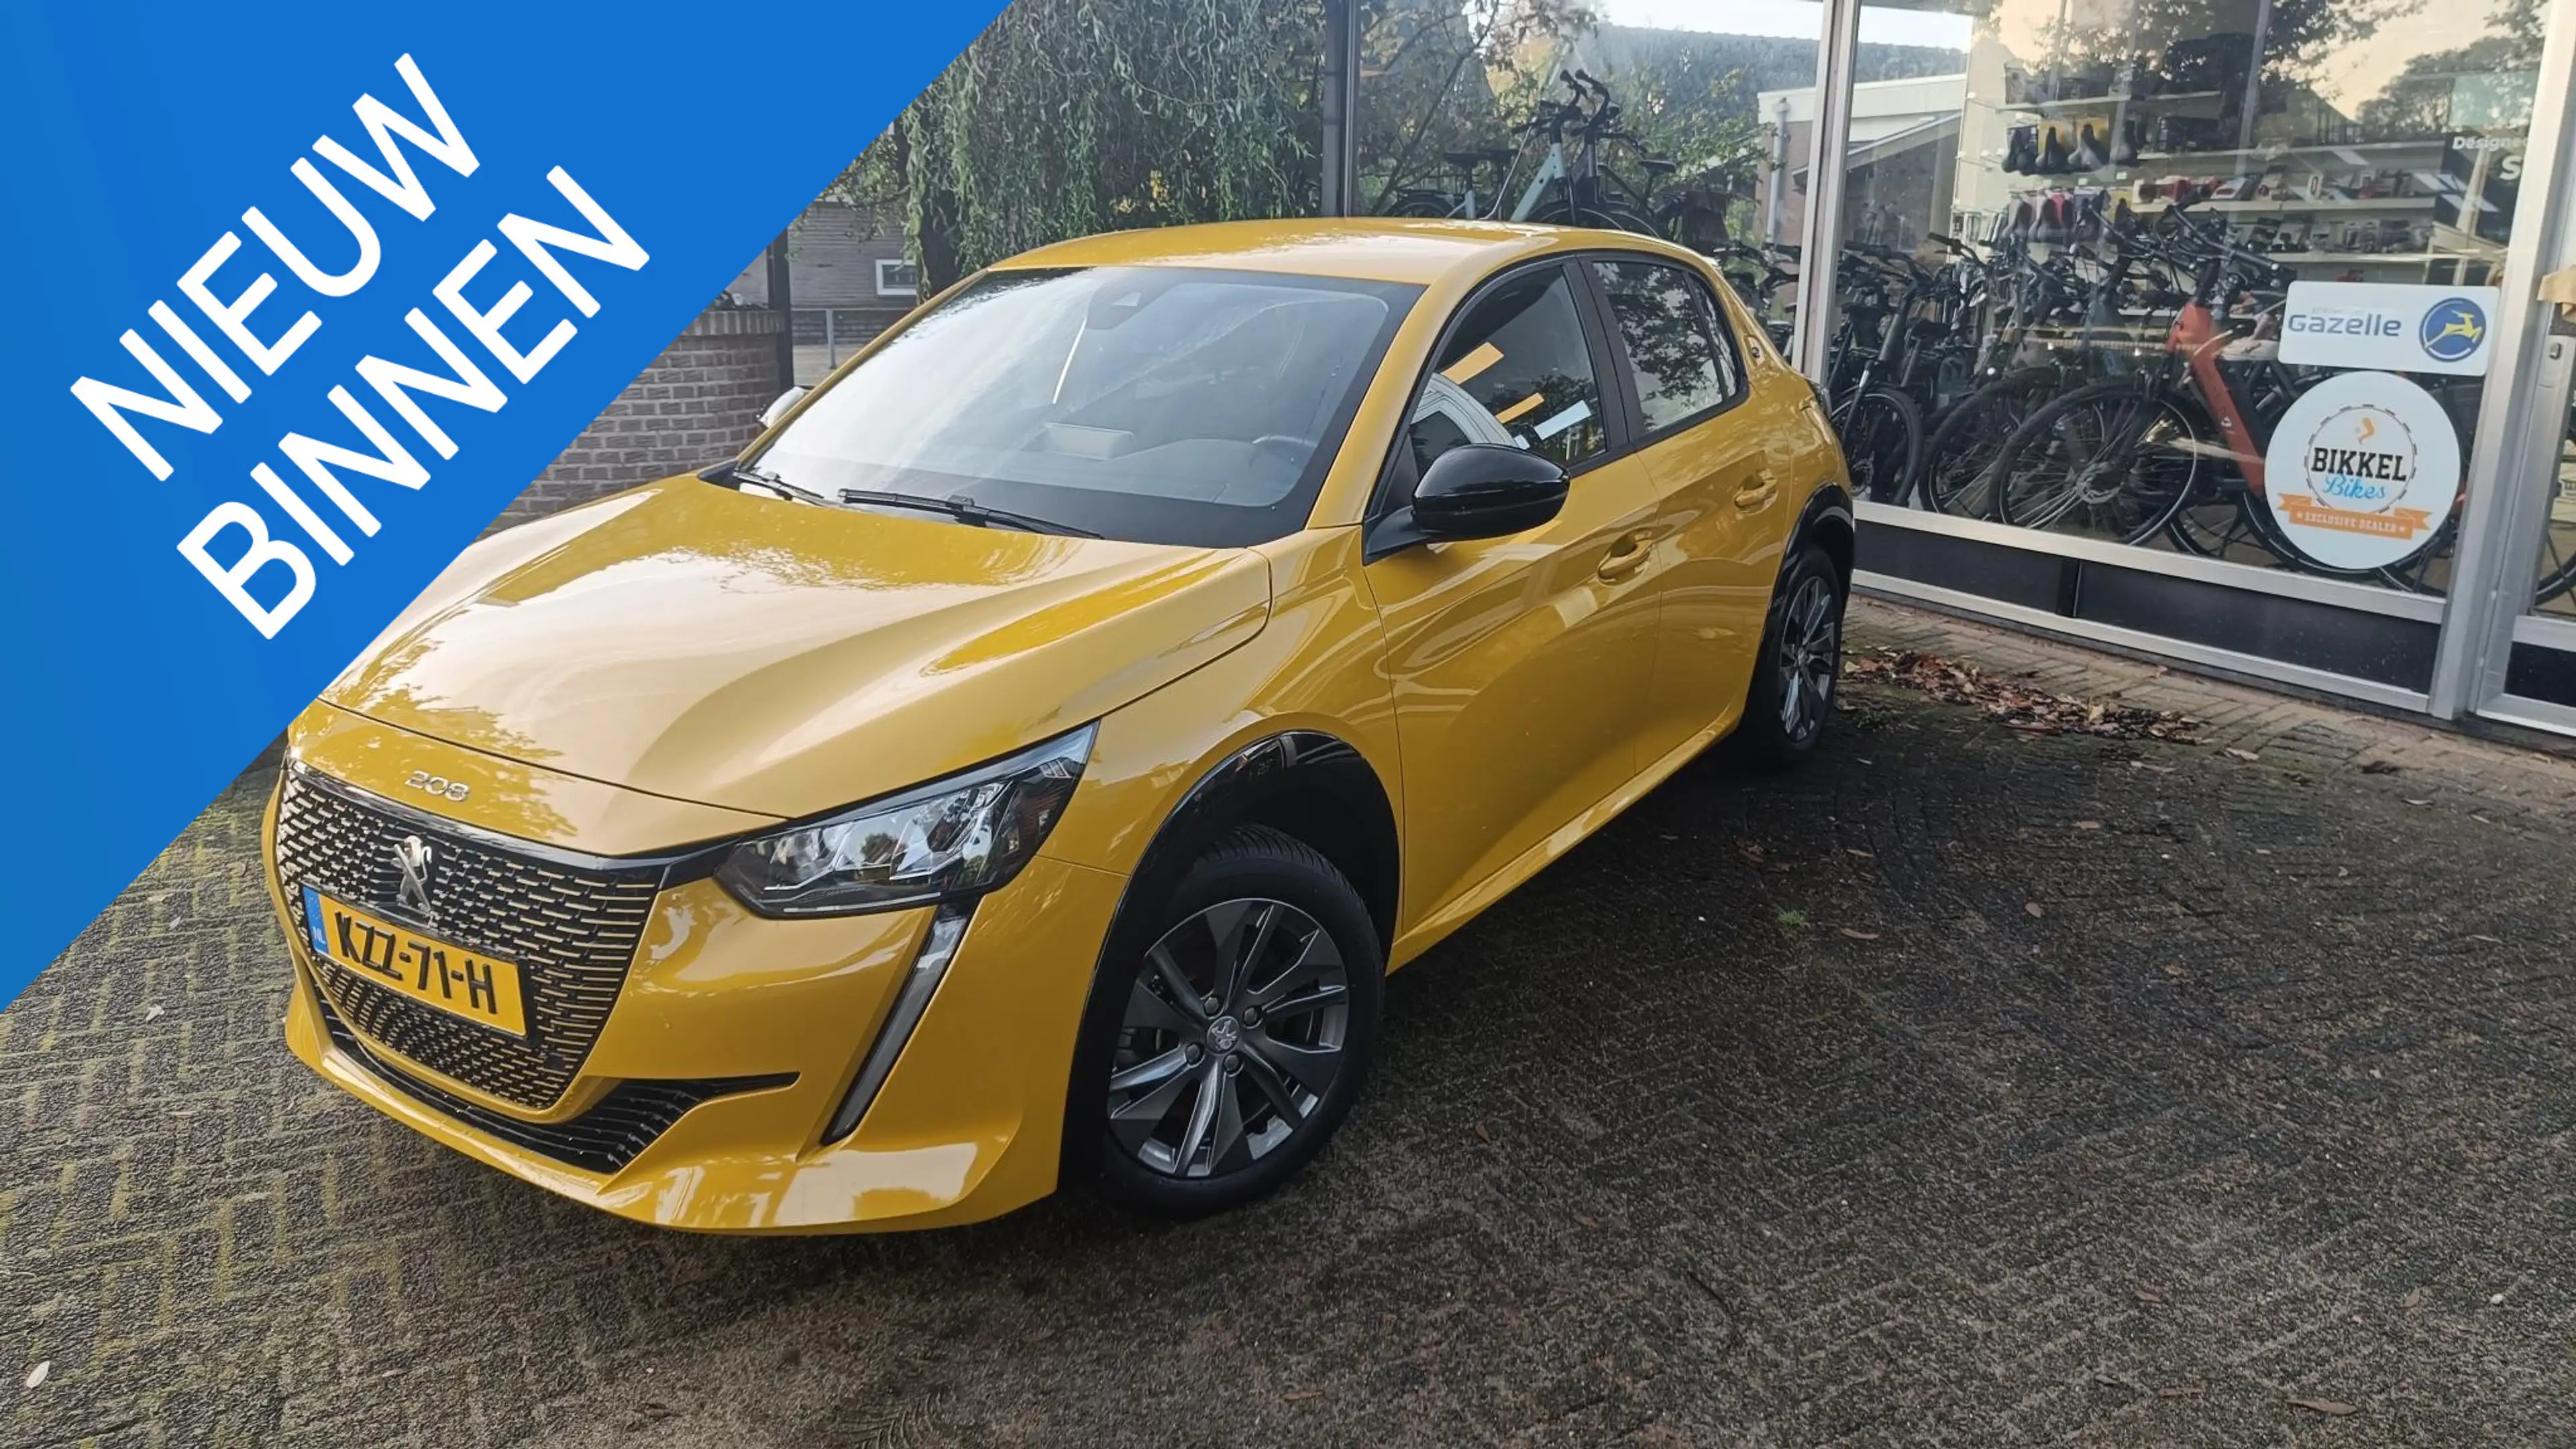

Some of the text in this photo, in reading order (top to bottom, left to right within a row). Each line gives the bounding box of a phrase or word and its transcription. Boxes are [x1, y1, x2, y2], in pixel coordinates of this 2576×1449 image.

[2288, 313, 2402, 337] Gazelle
[2311, 447, 2407, 482] BIKKEL
[2322, 474, 2385, 499] Bikes
[2304, 512, 2397, 533] EXCLUSIVE DEALER
[405, 770, 469, 801] 208
[335, 911, 497, 1014] KZZ-71-H
